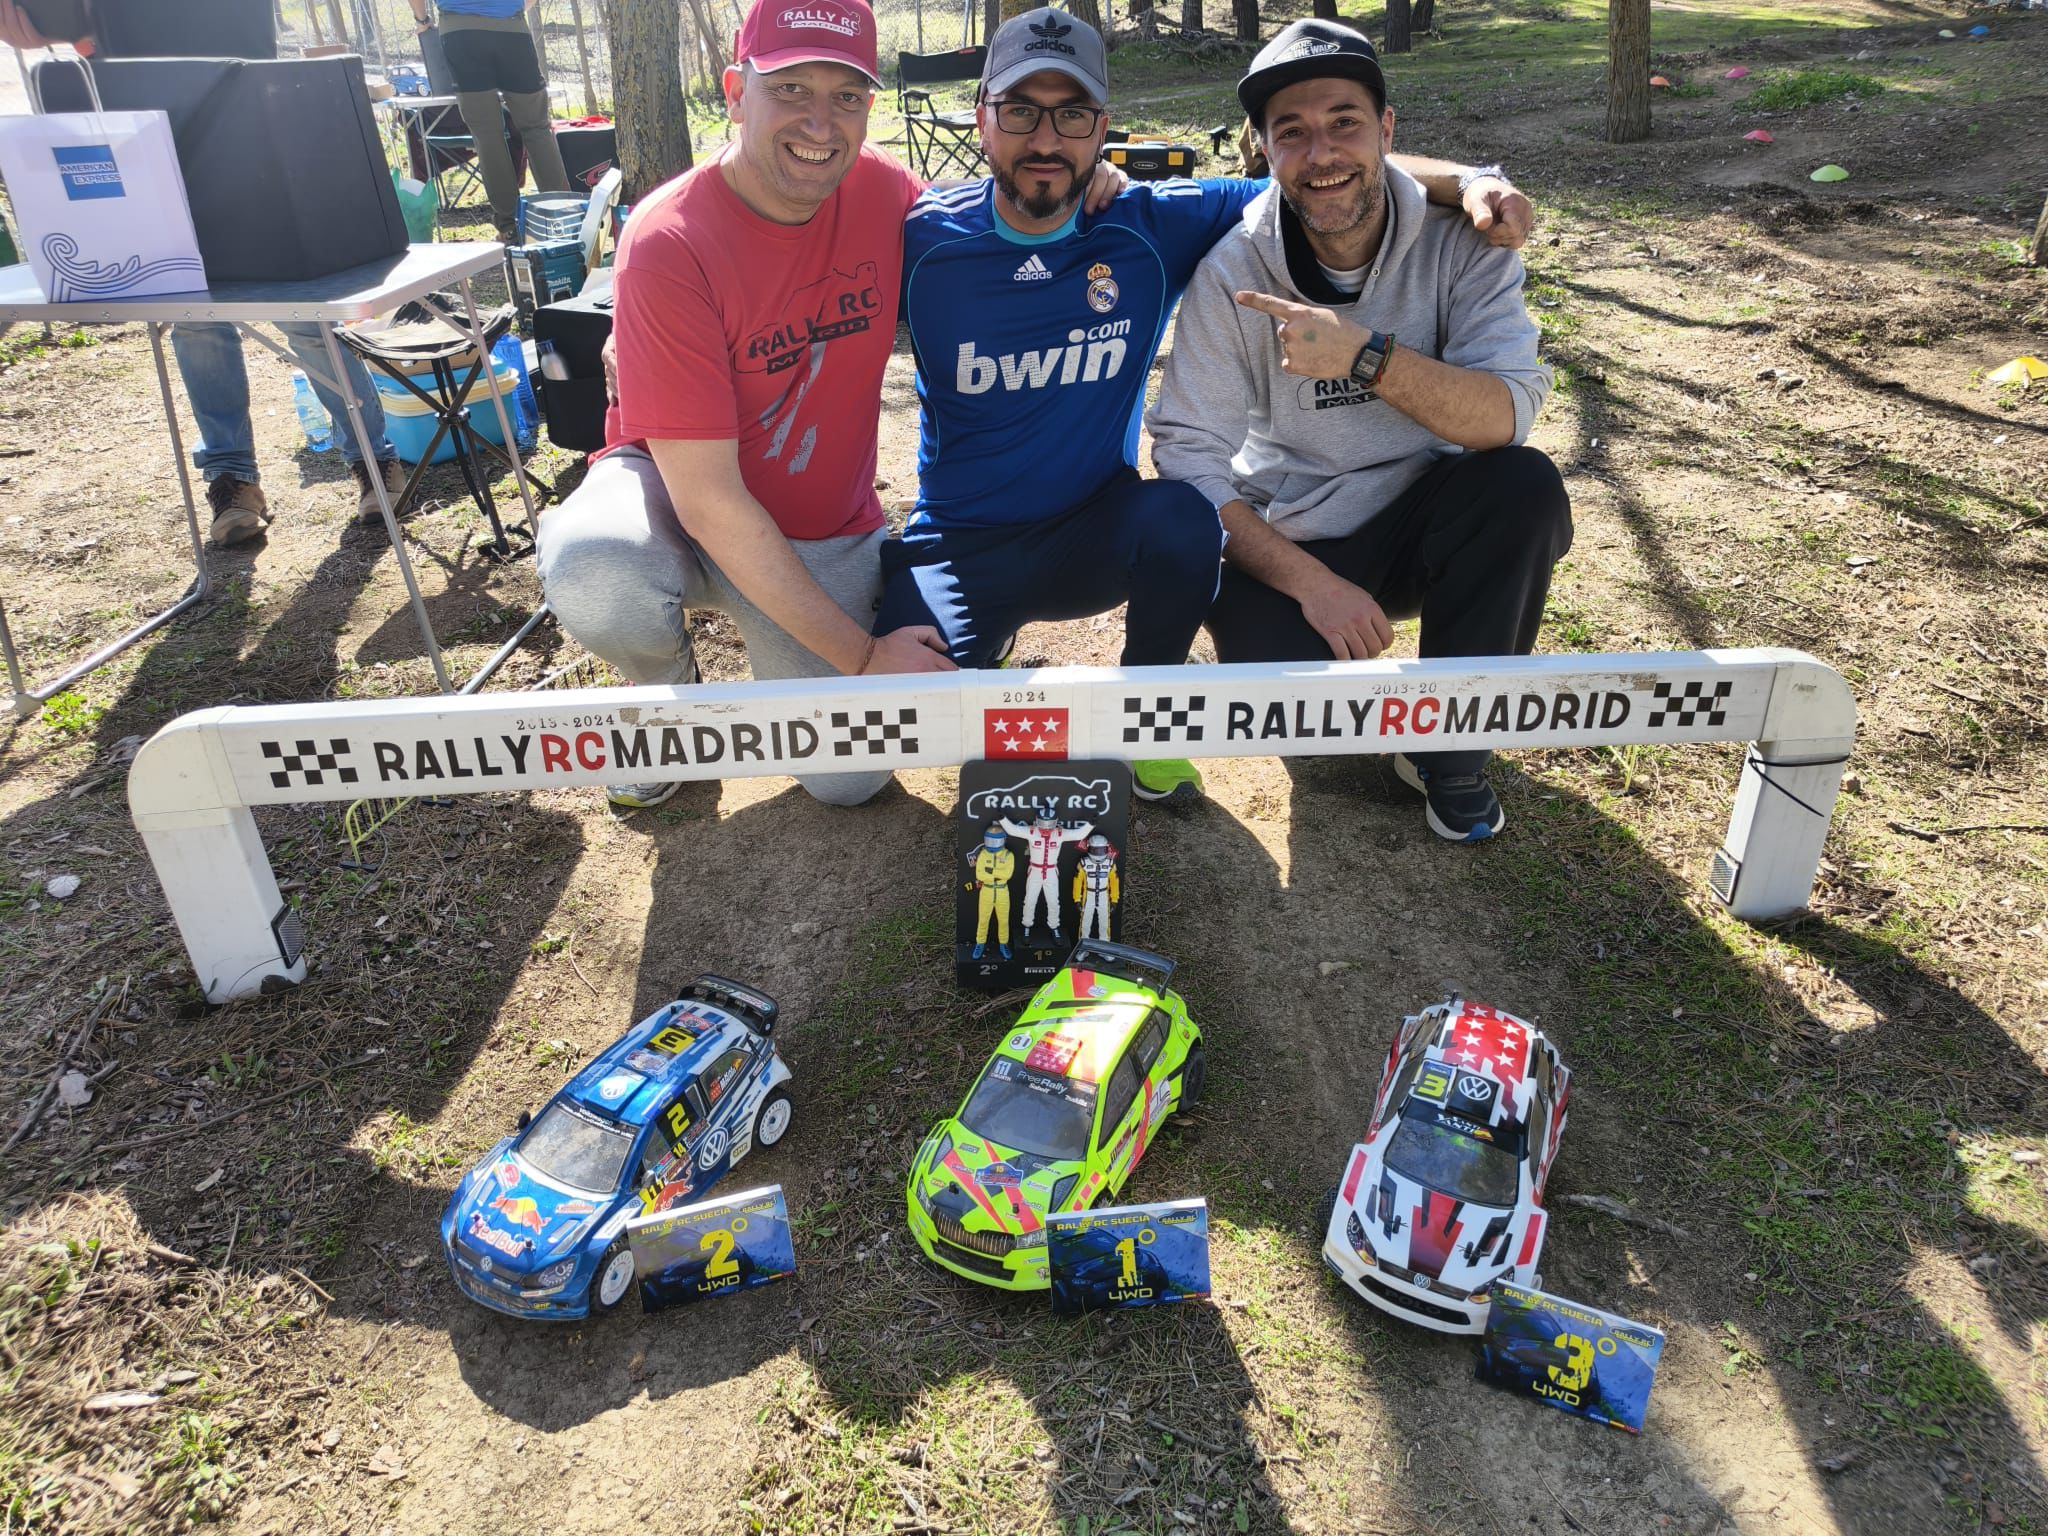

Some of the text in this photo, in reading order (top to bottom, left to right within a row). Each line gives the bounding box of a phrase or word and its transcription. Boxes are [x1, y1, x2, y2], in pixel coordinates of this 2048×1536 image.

[784, 10, 858, 31] RALLY RC
[1024, 40, 1076, 55] adidas
[74, 174, 122, 184] EXPRESS
[1013, 271, 1053, 281] adidas
[838, 287, 878, 316] RC
[1087, 318, 1131, 341] com
[956, 329, 1128, 395] bwin
[1003, 690, 1047, 703] 2024
[984, 795, 1097, 809] RALLY RC
[1016, 1070, 1040, 1084] Free
[1040, 1077, 1068, 1095] Rally
[1417, 1073, 1448, 1097] 3
[667, 1102, 691, 1138] 2
[693, 1207, 732, 1224] SUECIA
[1056, 1215, 1150, 1231] RALLY RC SUECIA
[697, 1274, 741, 1292] 4WD
[1108, 1287, 1153, 1301] 4WD
[1560, 1307, 1603, 1326] SUECIA
[1532, 1380, 1581, 1407] 4WD
